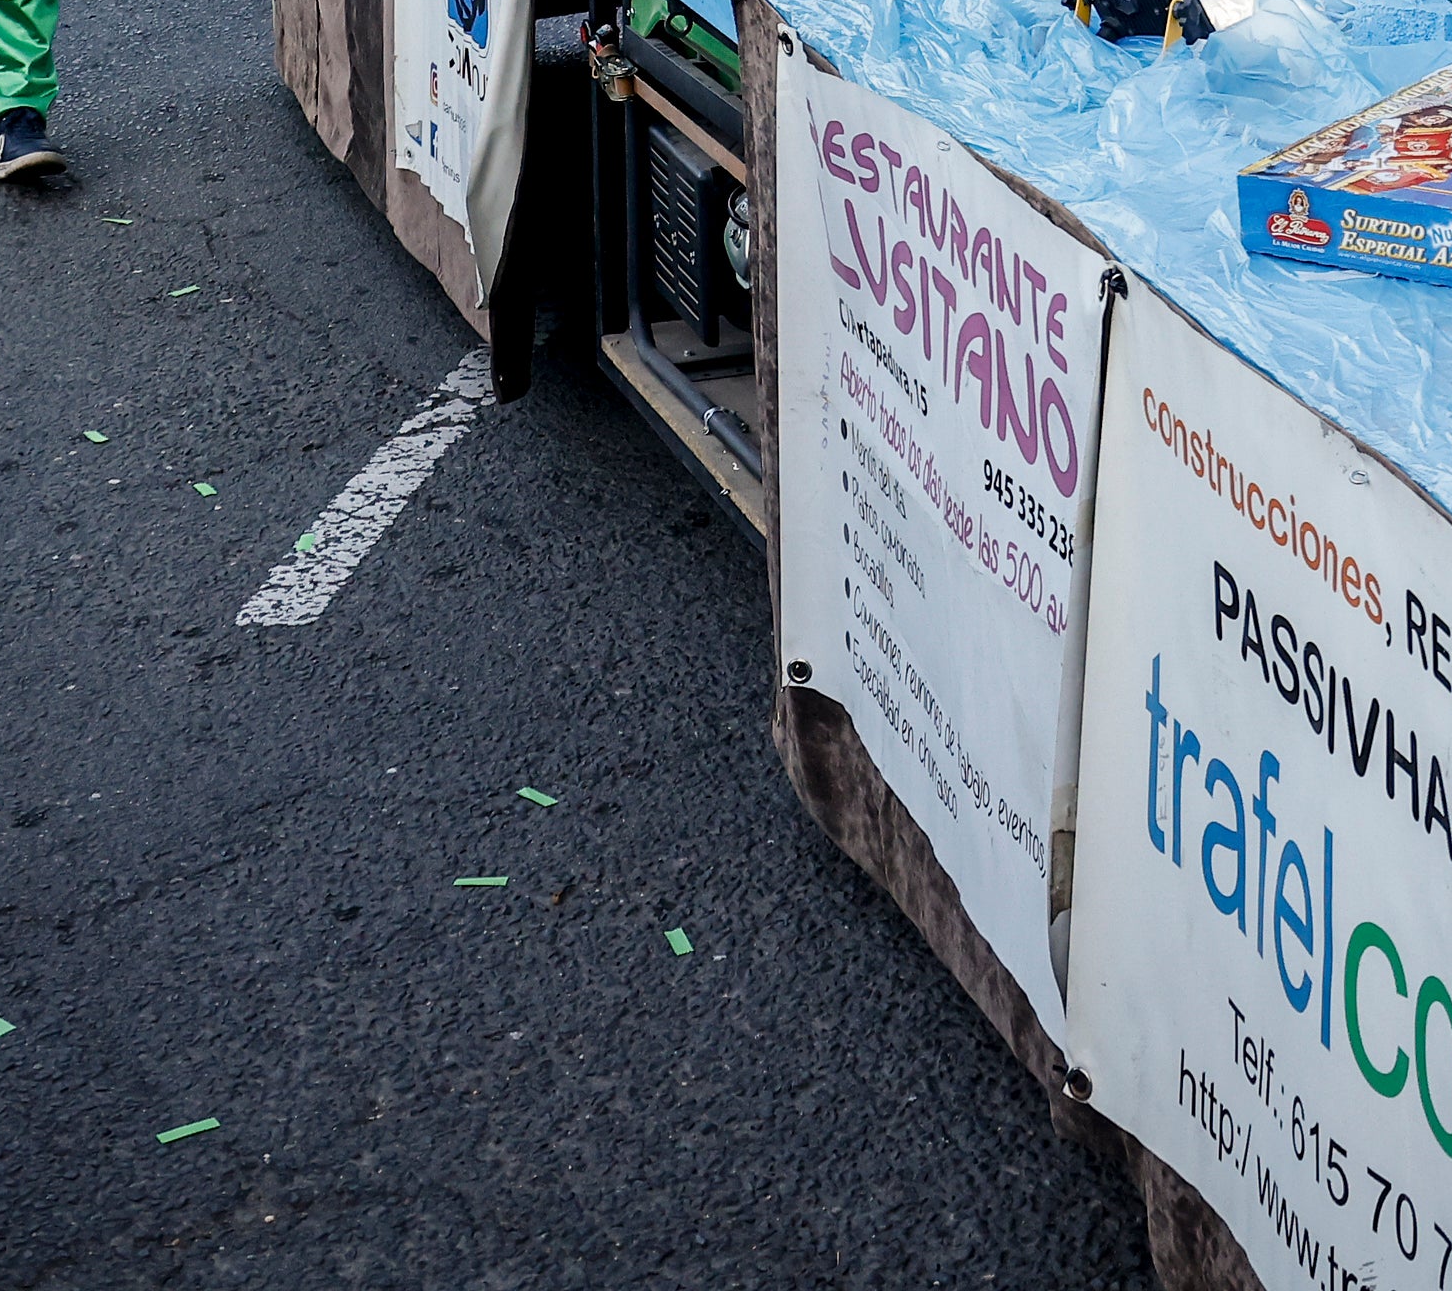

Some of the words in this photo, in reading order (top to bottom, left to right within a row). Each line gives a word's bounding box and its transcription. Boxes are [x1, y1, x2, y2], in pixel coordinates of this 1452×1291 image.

[811, 103, 1068, 374] ESTAURANTE
[1338, 231, 1428, 263] ESPECIAL
[1341, 208, 1426, 241] SURTIDO
[983, 459, 1014, 510] 945
[1017, 486, 1045, 539] 335
[978, 514, 1000, 574] las
[998, 797, 1047, 879] eventos,
[1292, 1095, 1350, 1207] 615
[1367, 1165, 1419, 1262] 70
